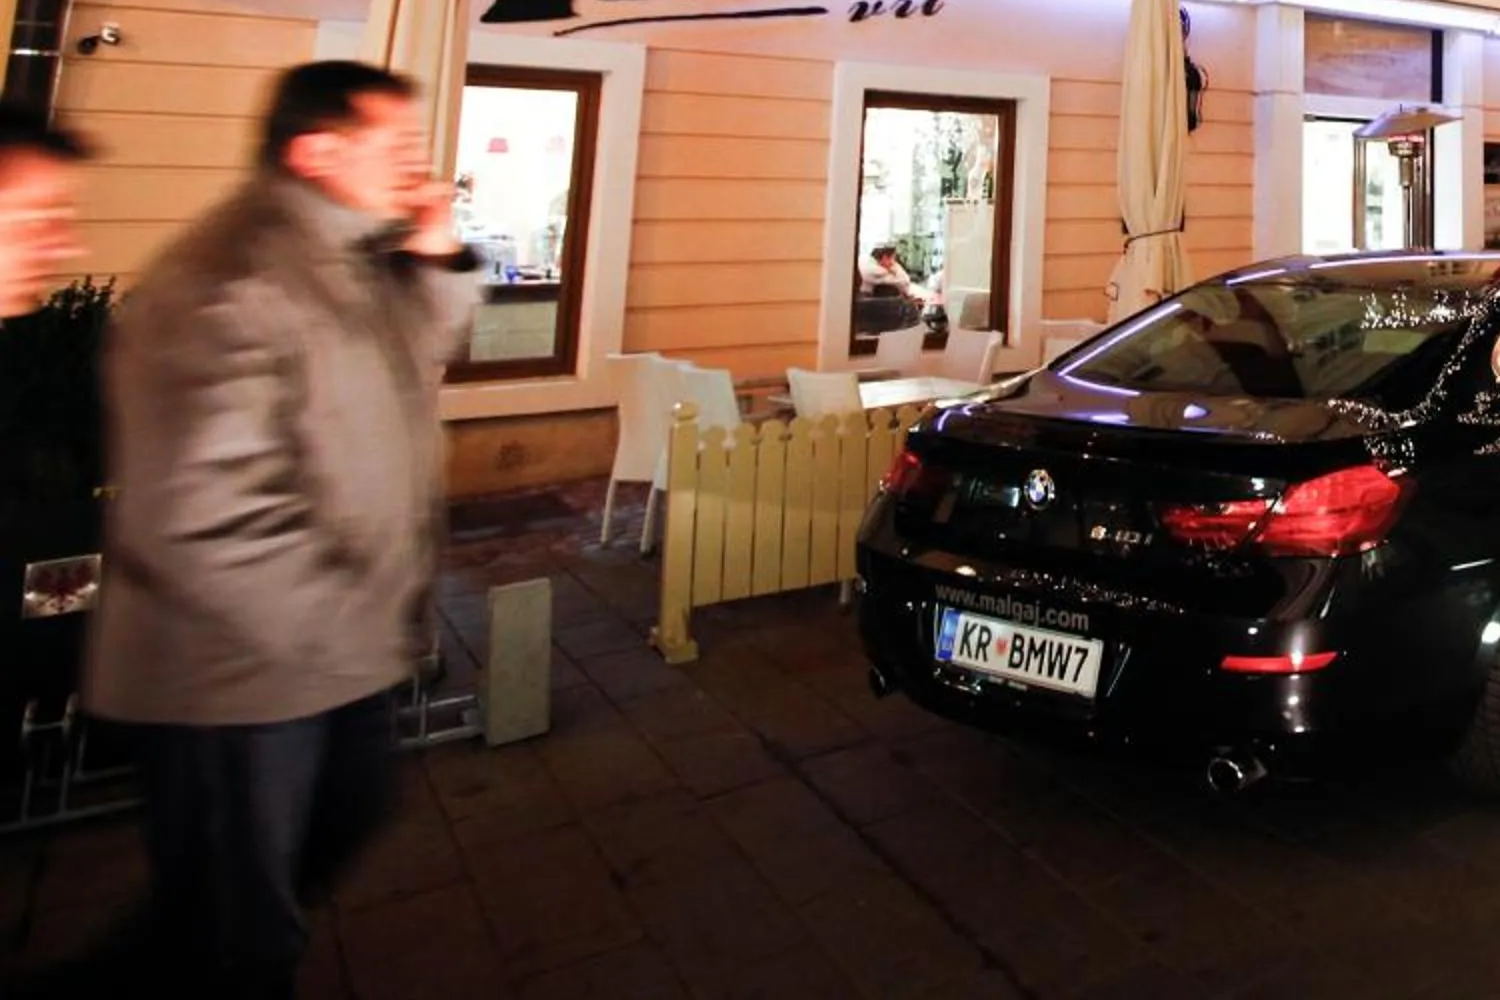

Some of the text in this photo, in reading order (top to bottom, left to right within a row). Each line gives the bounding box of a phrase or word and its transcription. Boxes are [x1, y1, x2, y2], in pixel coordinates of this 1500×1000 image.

[934, 583, 1090, 632] www.malgaj.com
[959, 621, 1090, 684] KR BMW7
